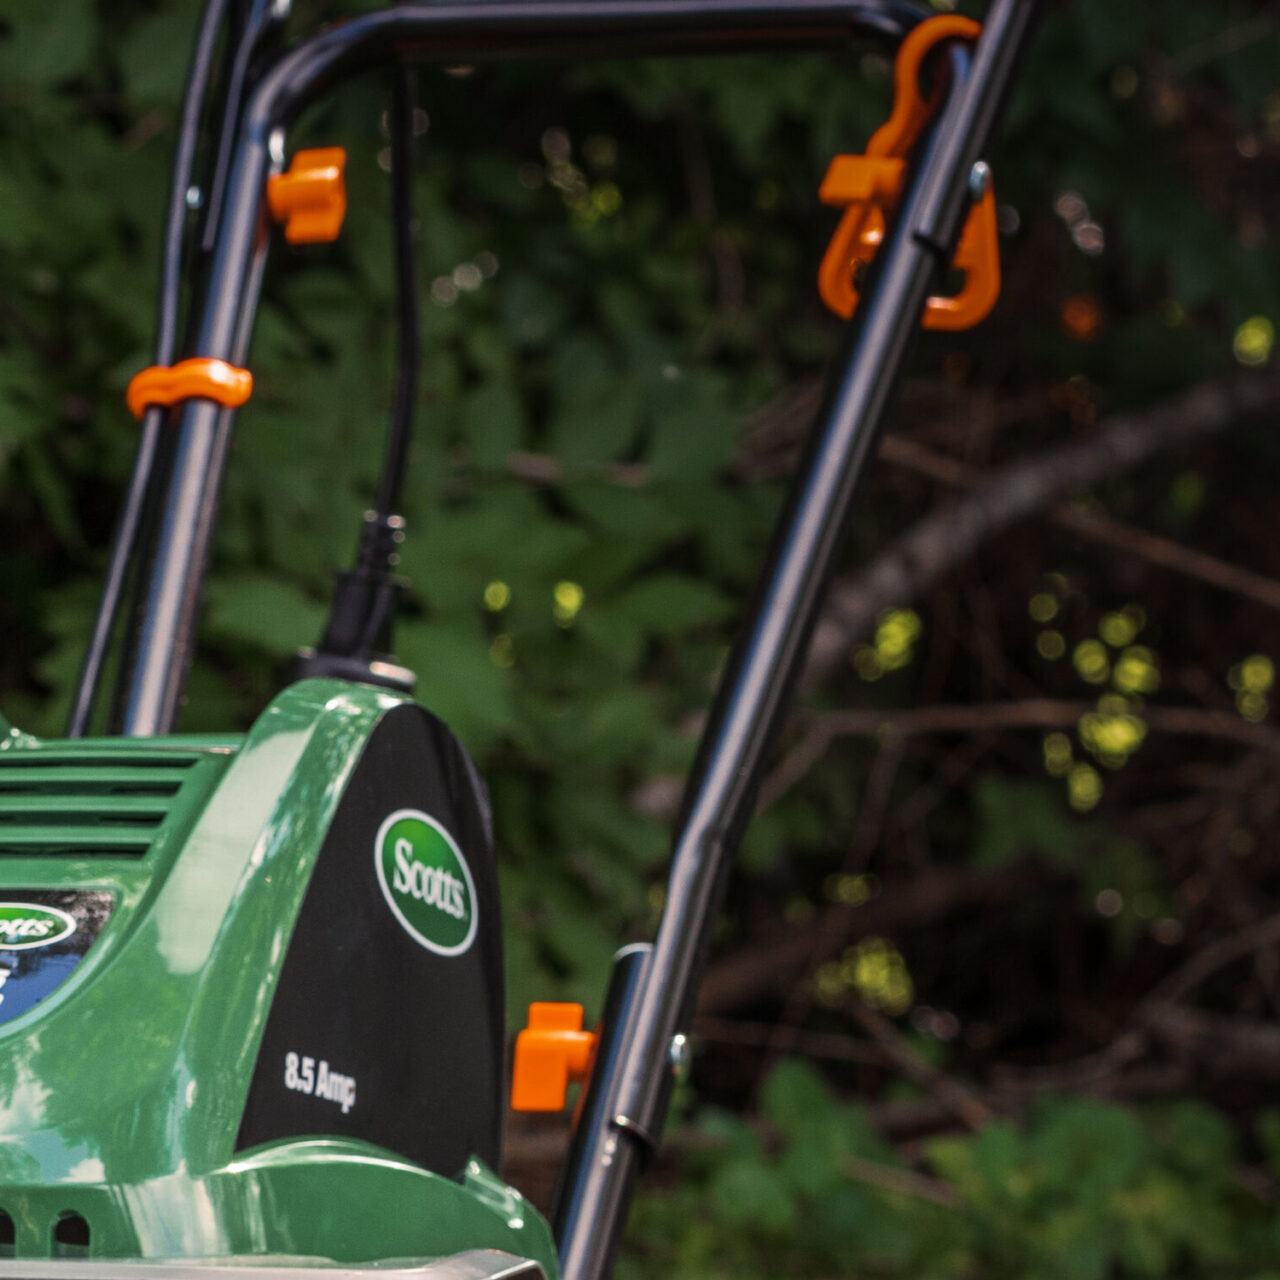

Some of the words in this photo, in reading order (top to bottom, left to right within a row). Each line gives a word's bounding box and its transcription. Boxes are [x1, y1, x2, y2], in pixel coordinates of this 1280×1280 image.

[393, 838, 465, 921] Scotts
[285, 1052, 314, 1095] 8.5
[315, 1060, 357, 1114] Amp
